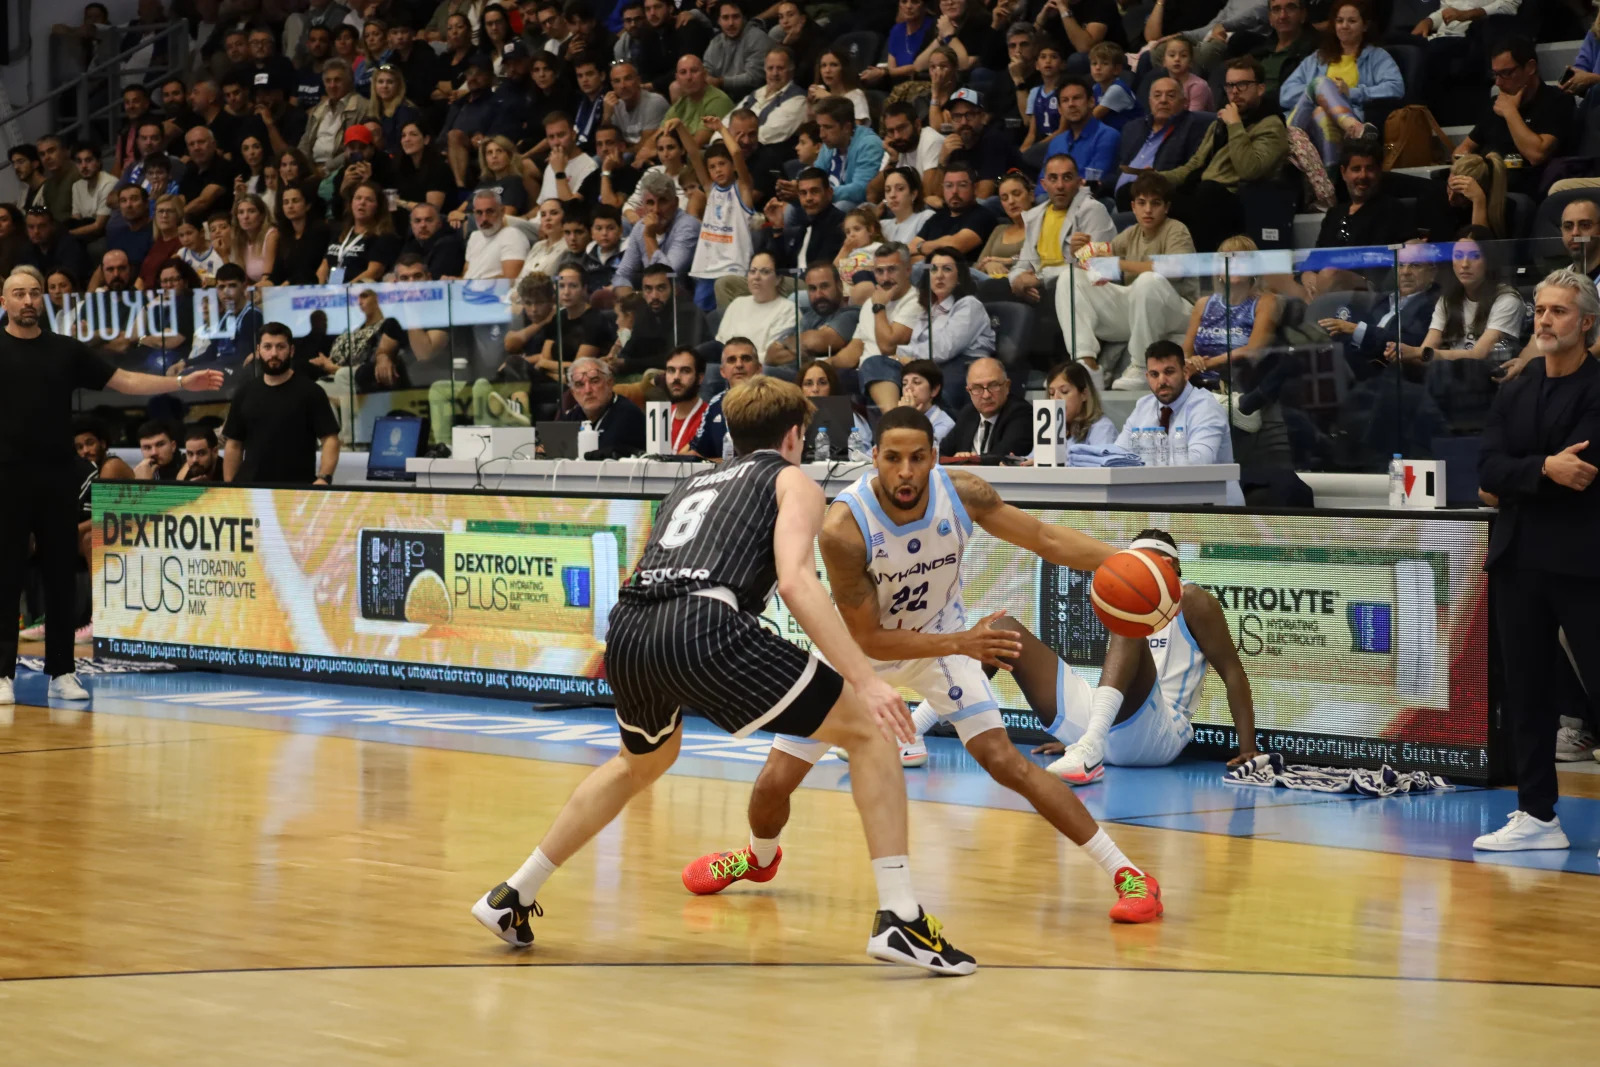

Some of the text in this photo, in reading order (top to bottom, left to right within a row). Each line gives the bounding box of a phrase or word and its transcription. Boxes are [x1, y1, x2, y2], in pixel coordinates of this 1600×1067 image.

[659, 488, 719, 549] 8
[188, 558, 246, 578] HYDRATING
[104, 553, 185, 614] PLUS
[188, 579, 256, 599] ELECTROLYTE
[455, 576, 508, 611] PLUS
[510, 580, 544, 591] HYDRATING
[510, 592, 548, 603] ELECTROLYTE
[889, 581, 929, 615] 22
[188, 600, 207, 616] MIX
[1267, 618, 1319, 633] HYDRATING
[1267, 632, 1327, 647] ELECTROLYTE
[108, 639, 119, 652] Τα
[121, 642, 187, 659] συμπληρώματα
[189, 646, 237, 666] διατροφής
[238, 650, 254, 664] δεν
[255, 652, 287, 669] πρέπει
[288, 657, 301, 668] να
[302, 656, 389, 676] χρησιμοποιούνται
[391, 665, 406, 680] ως
[407, 665, 484, 683] υποκατάστατο
[485, 673, 509, 689] μιας
[511, 675, 595, 696] ισορροπημένης
[1268, 734, 1397, 763] ισορροπημένης
